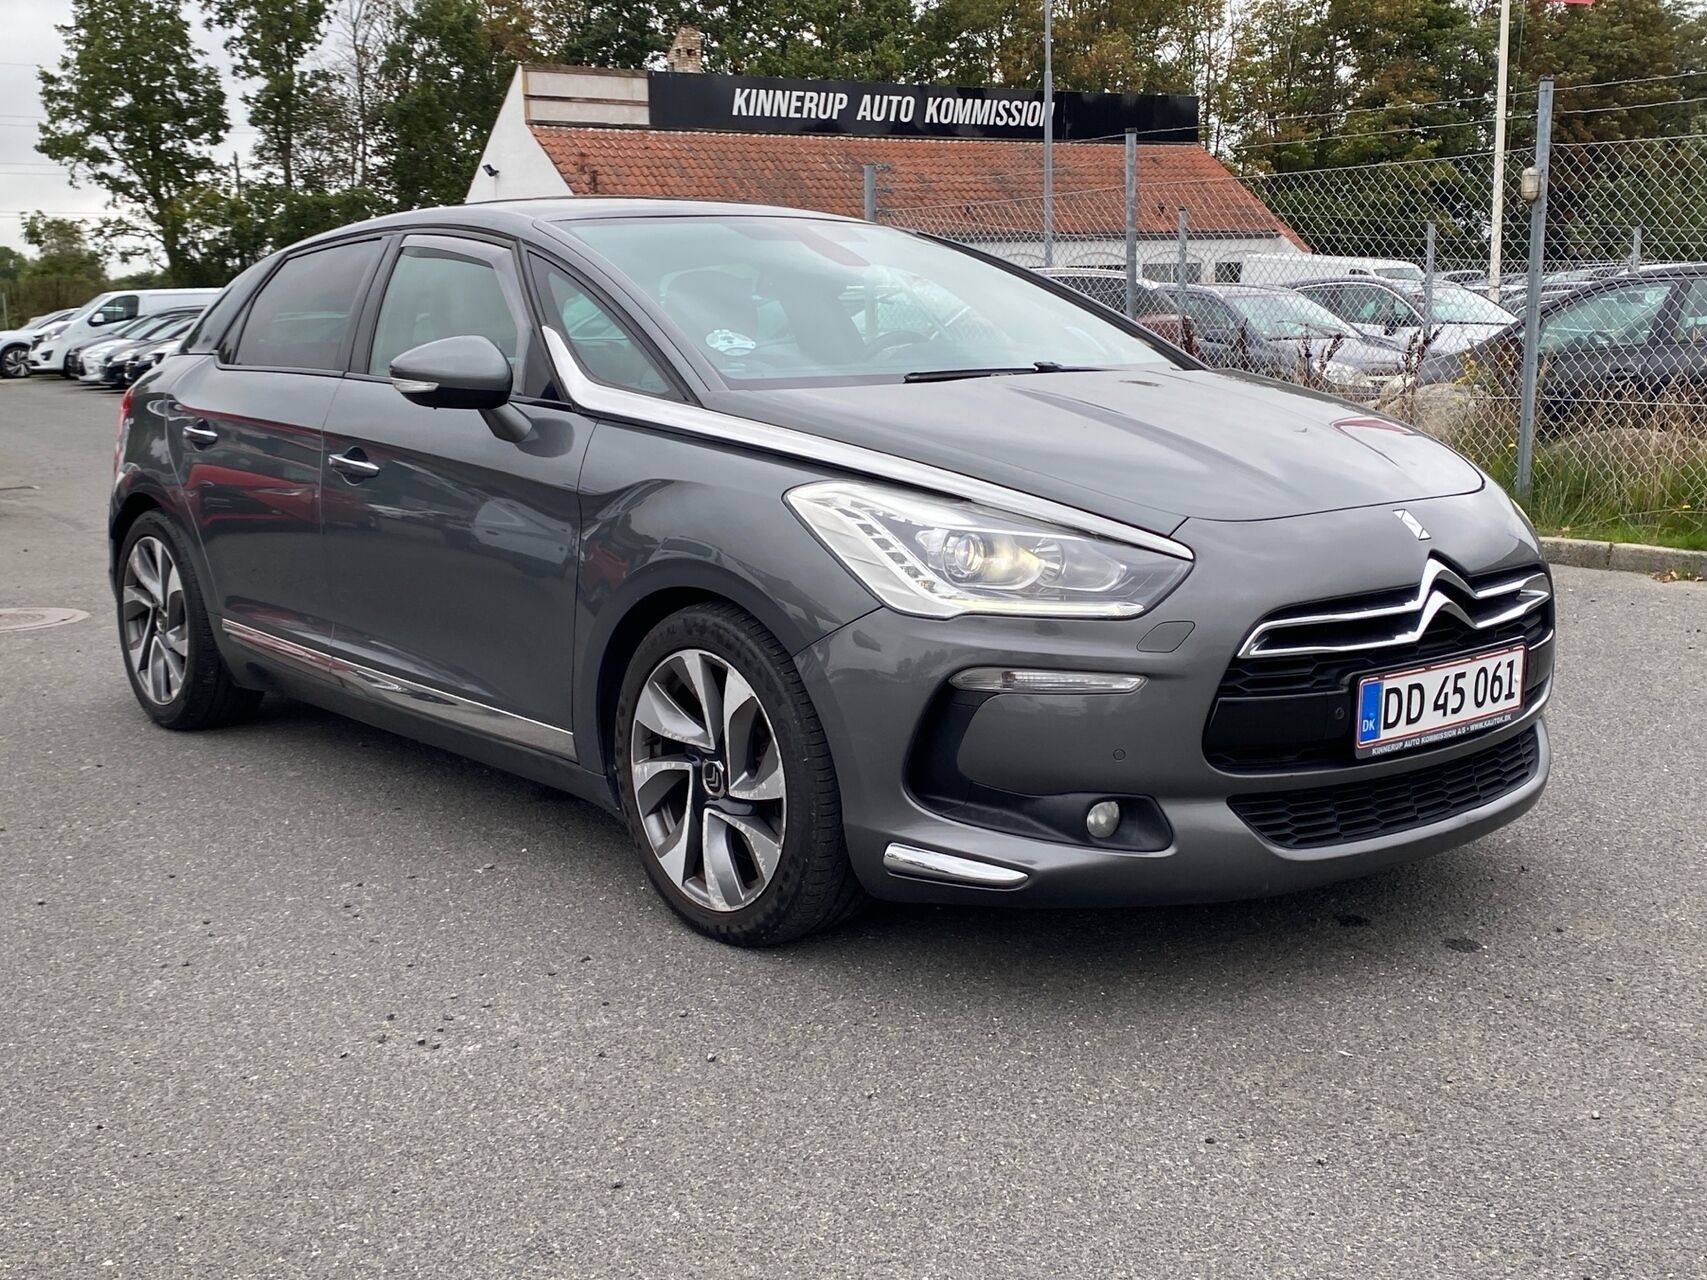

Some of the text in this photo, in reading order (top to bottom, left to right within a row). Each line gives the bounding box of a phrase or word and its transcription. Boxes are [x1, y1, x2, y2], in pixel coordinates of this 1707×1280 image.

[732, 88, 848, 120] KINNERUP
[856, 94, 915, 123] AUTO
[1383, 659, 1515, 730] DD 45 061
[1362, 719, 1376, 732] DK
[1404, 738, 1420, 749] AUTO
